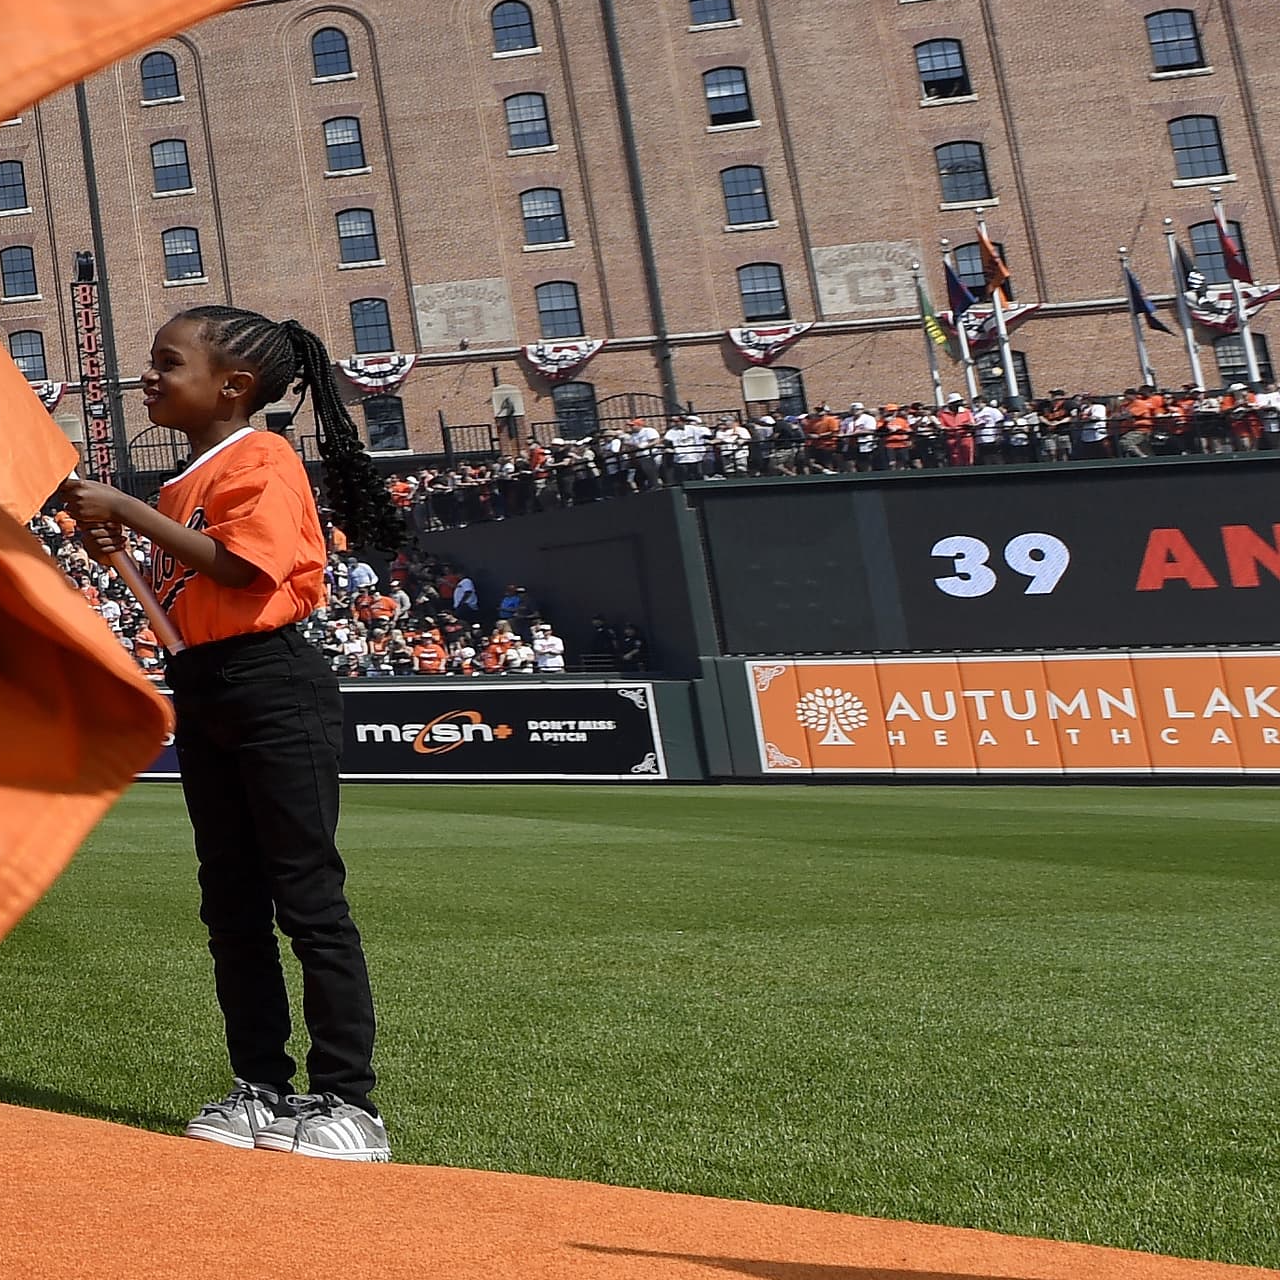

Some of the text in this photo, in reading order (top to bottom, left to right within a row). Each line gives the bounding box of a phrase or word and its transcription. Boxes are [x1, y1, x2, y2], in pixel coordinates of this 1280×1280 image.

[930, 532, 1071, 598] 39
[885, 687, 1137, 721] AUTUMN
[542, 732, 588, 742] PITCH
